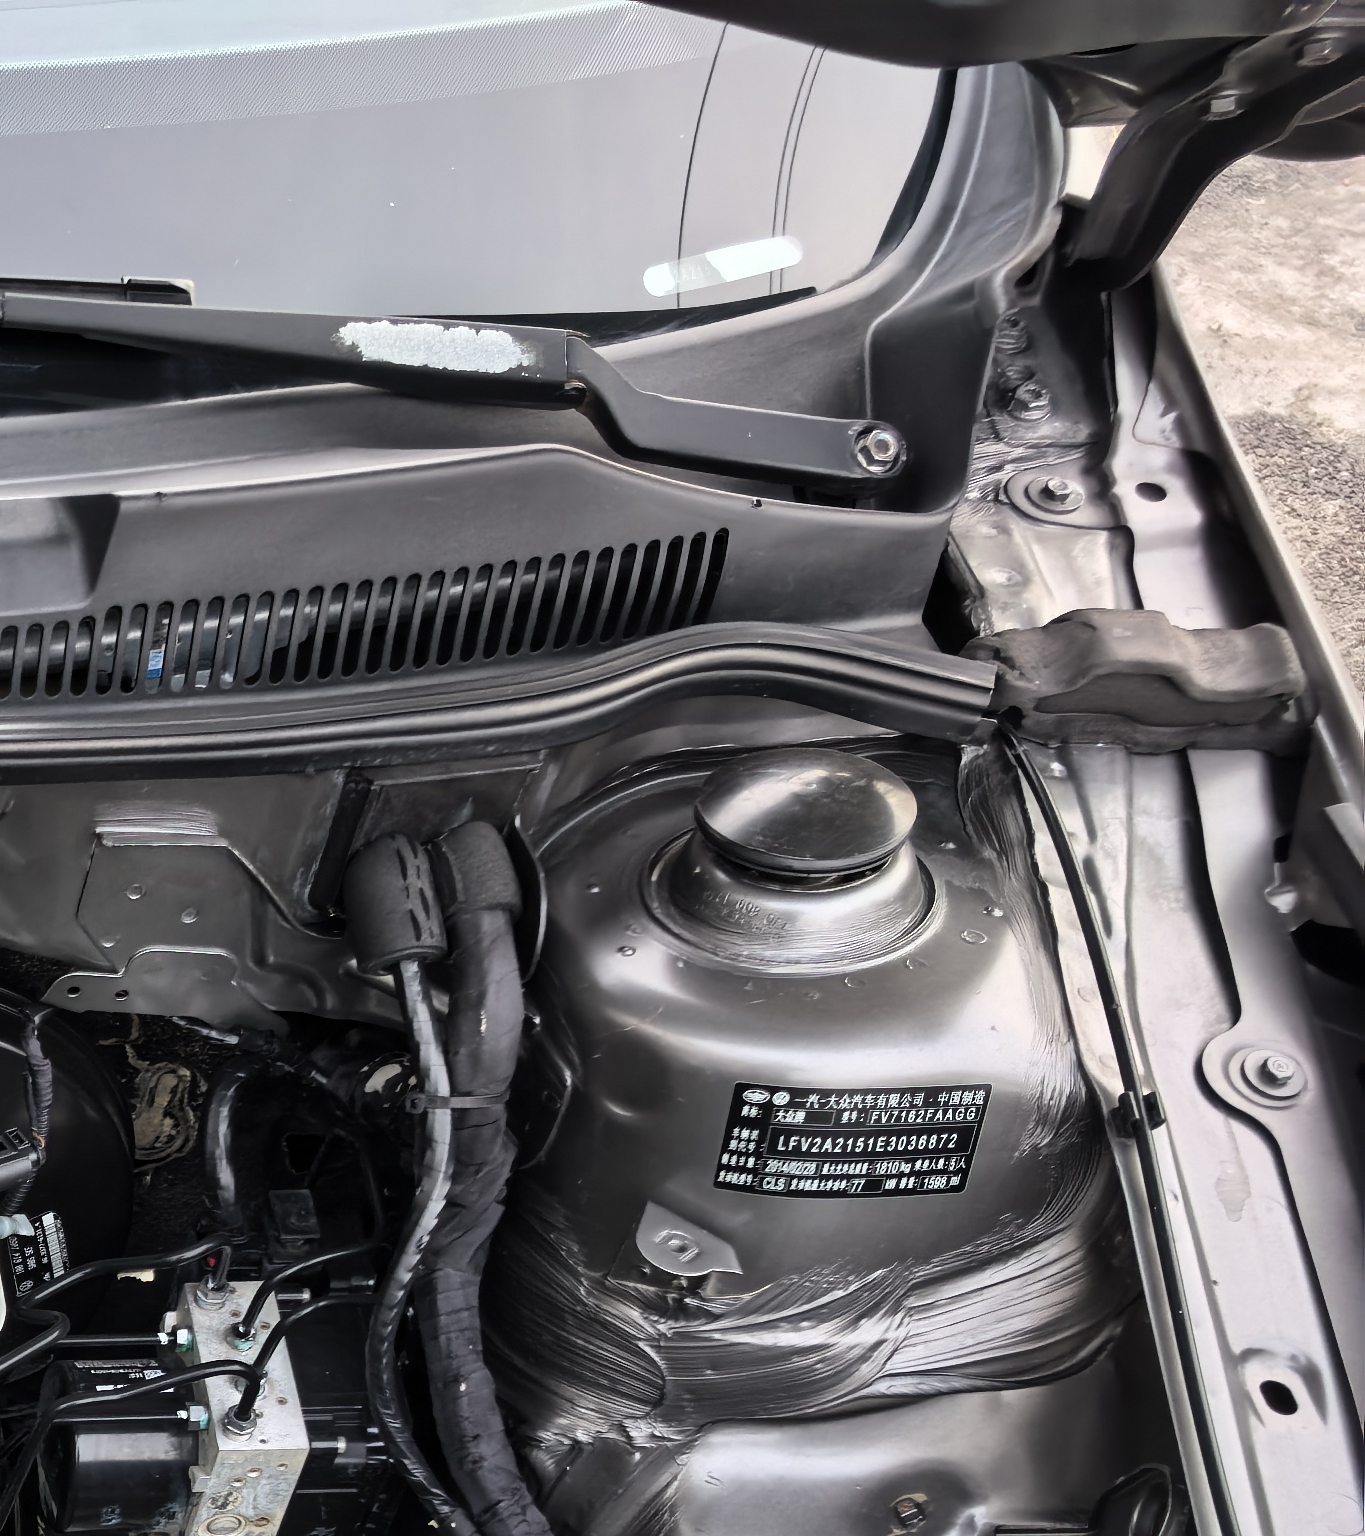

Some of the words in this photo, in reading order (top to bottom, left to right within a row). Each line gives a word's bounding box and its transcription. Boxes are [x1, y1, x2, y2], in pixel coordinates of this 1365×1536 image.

[870, 1108, 976, 1124] FV7162FAAGG
[777, 1134, 958, 1153] LFV2A2151E3036872
[762, 1176, 786, 1190] CLS
[851, 1180, 866, 1193] 77
[924, 1176, 947, 1190] 1598
